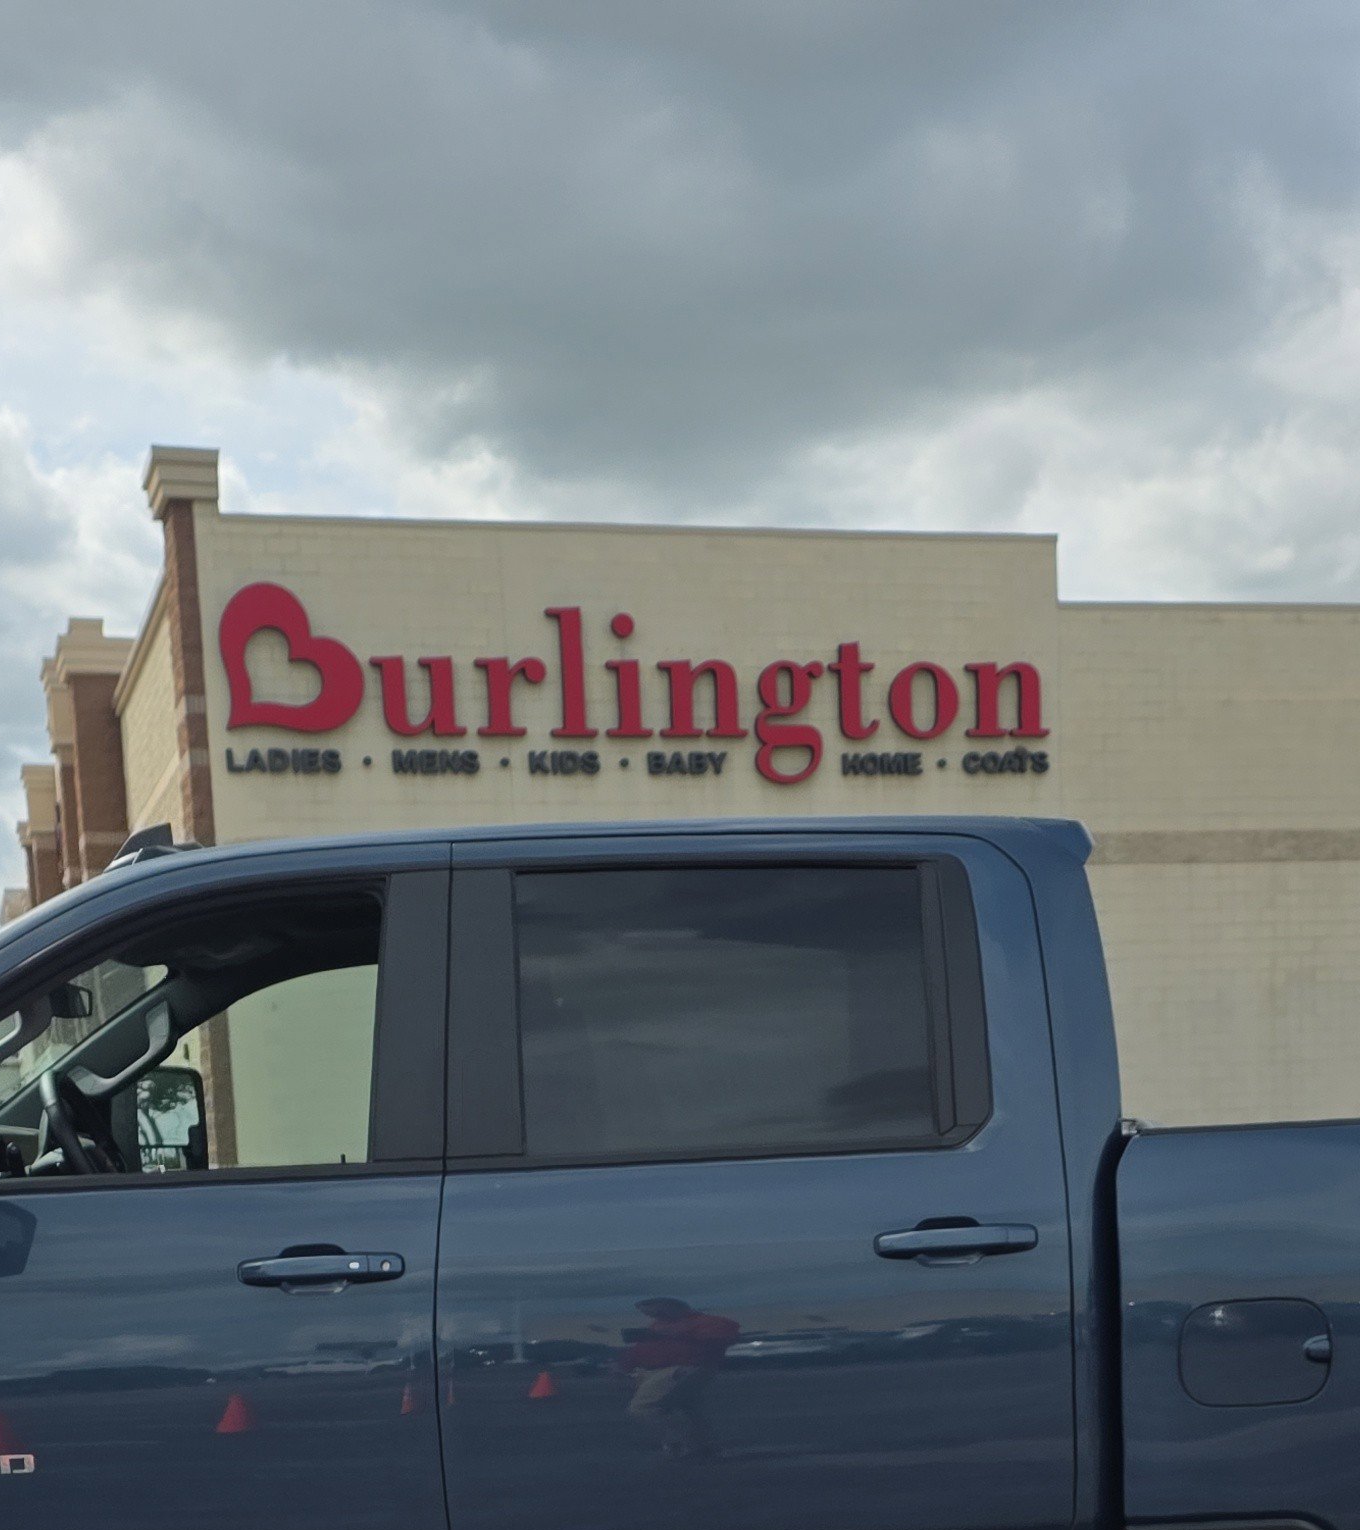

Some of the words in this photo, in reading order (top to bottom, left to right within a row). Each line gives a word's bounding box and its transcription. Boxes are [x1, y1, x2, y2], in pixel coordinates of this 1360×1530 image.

[219, 581, 1050, 784] Burlington
[226, 748, 342, 775] LADIES
[392, 749, 480, 775] MENS
[528, 750, 601, 776] KIDS
[647, 751, 728, 776] BABY
[841, 752, 923, 776] HOME
[962, 747, 1050, 775] COATS
